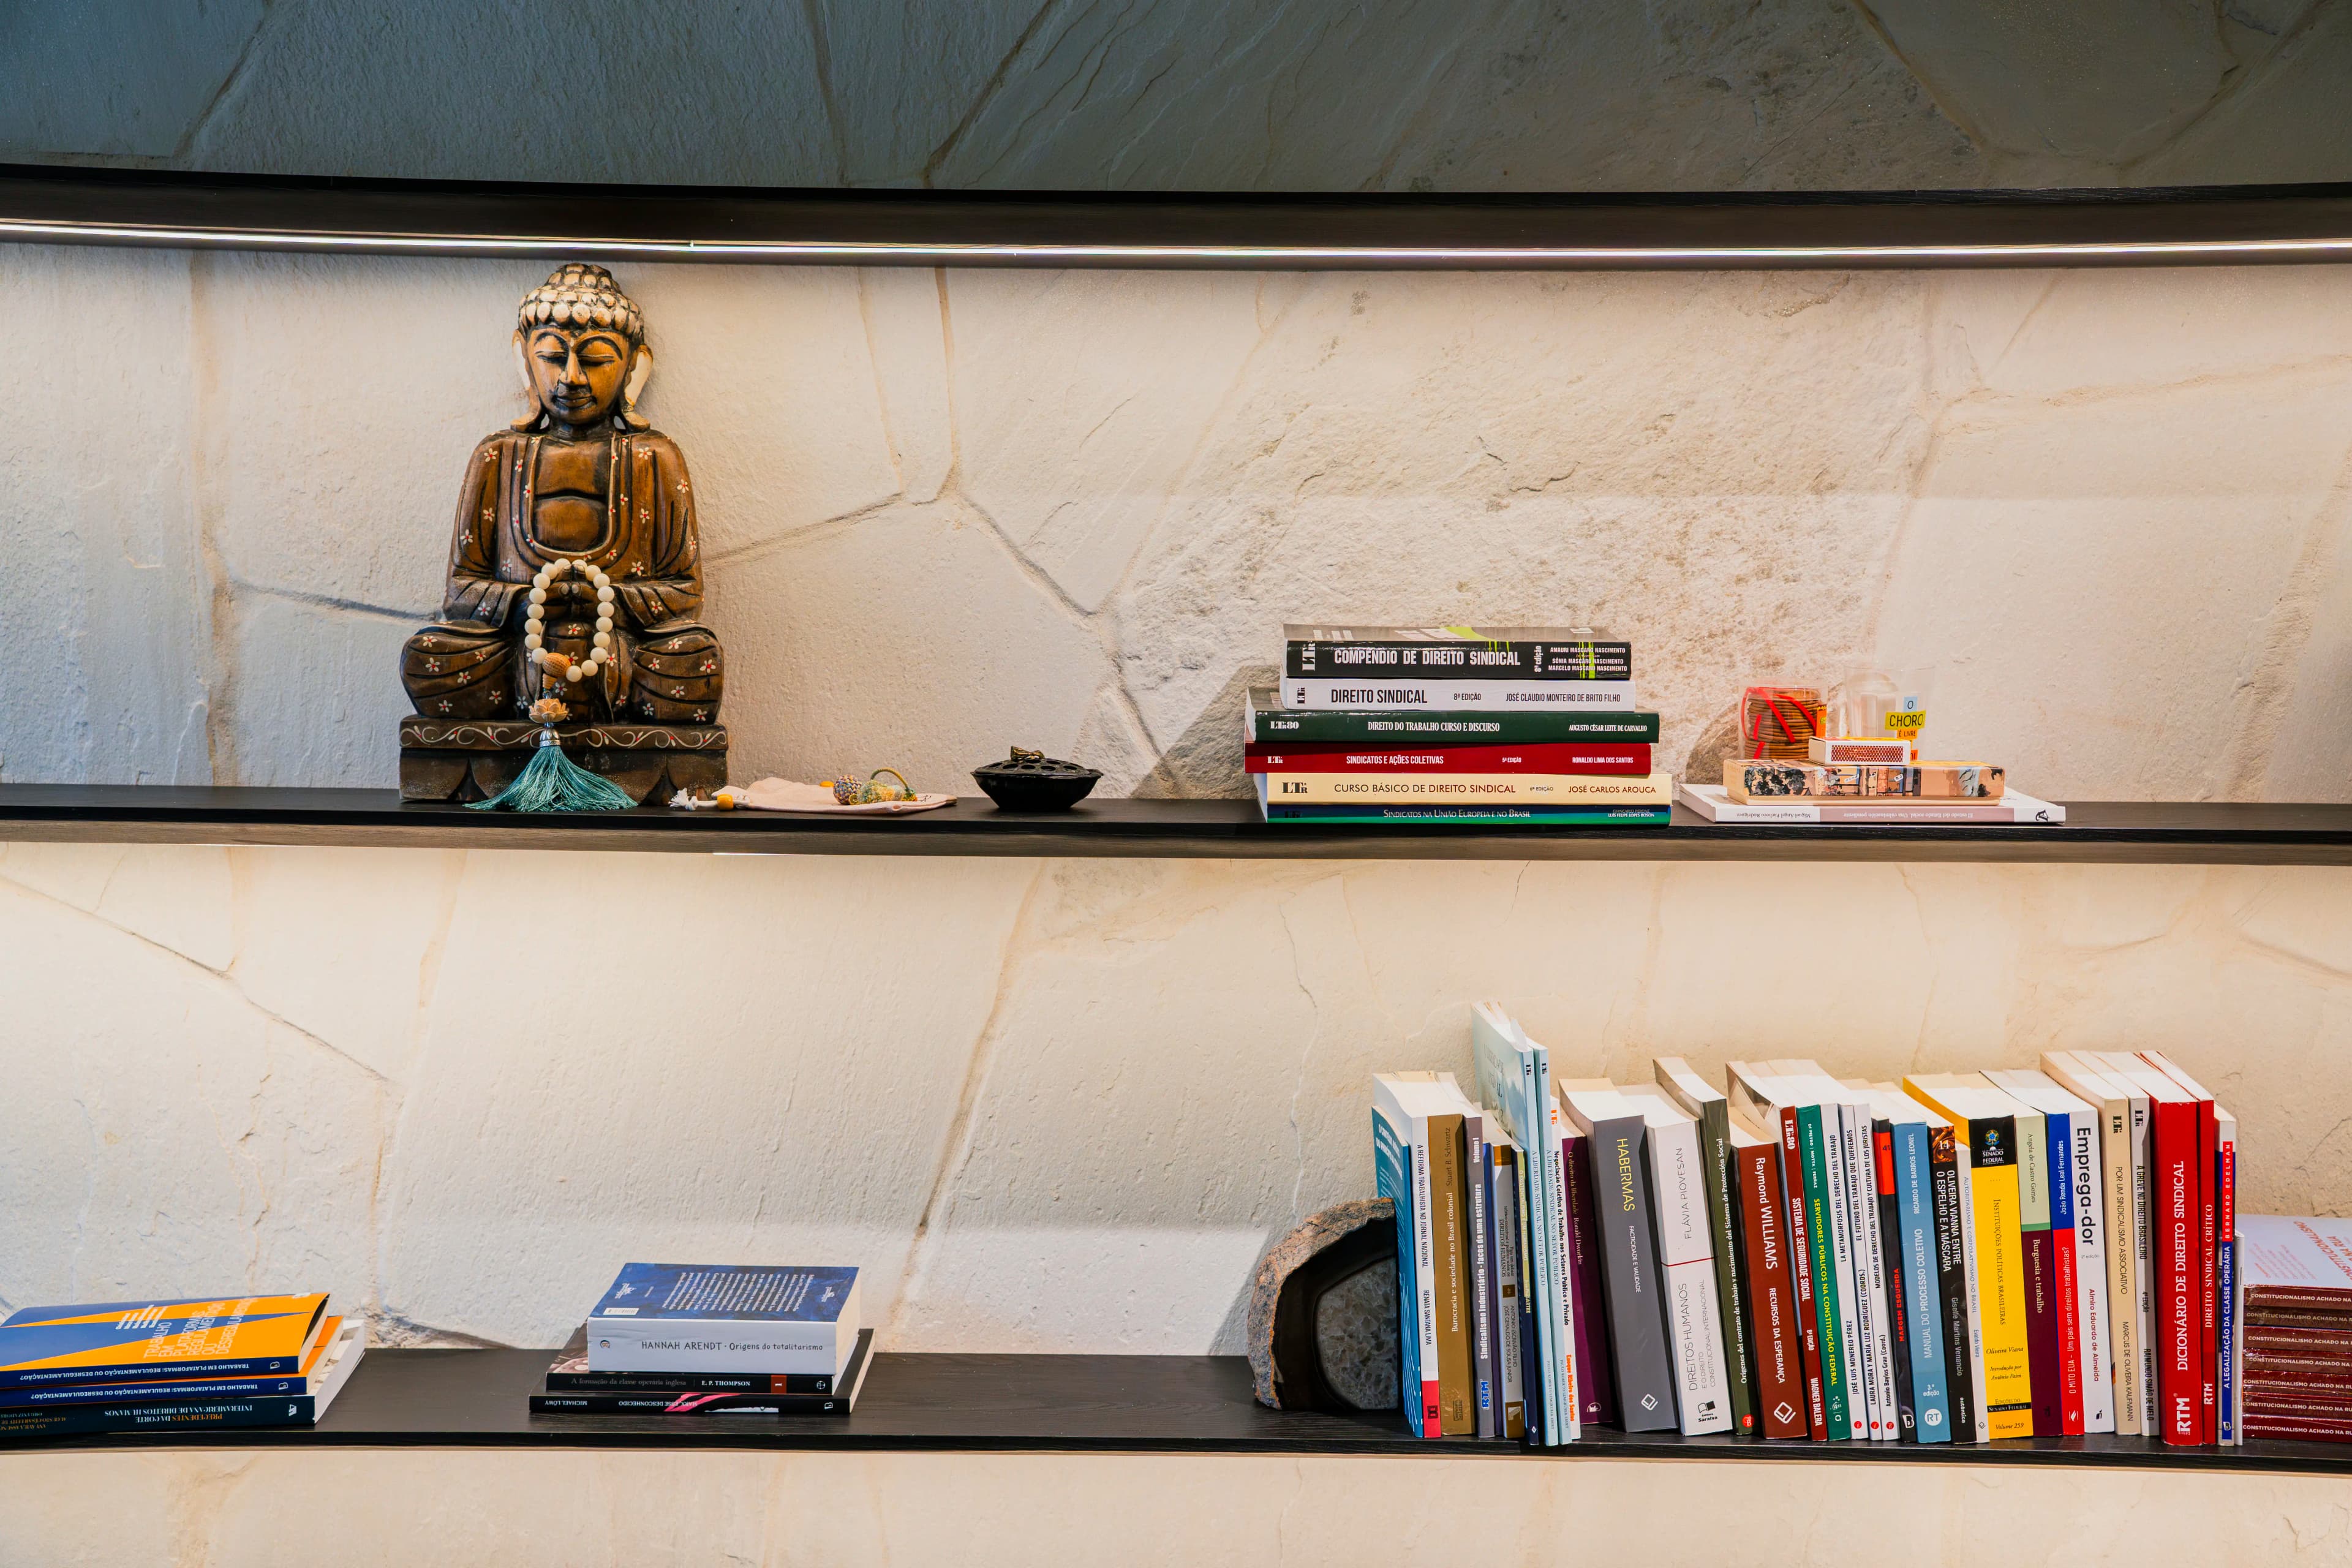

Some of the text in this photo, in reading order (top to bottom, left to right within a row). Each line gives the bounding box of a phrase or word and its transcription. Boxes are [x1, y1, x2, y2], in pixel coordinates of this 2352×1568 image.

[1403, 650, 1417, 664] DE
[1422, 650, 1464, 665] DIREITO
[1469, 650, 1520, 665] SINDICAL
[1331, 689, 1428, 703] DIREITO SINDICAL
[1461, 692, 1481, 702] EDIÇÃO
[1506, 692, 1520, 701] JOSÉ
[1546, 693, 1575, 702] MONTEIRO
[1586, 693, 1603, 702] BRITO
[1907, 701, 1913, 709] O
[1368, 721, 1499, 731] DIREITO DO TRABALHO CURSO E DISCURSO
[1890, 714, 1923, 727] CHORO
[1346, 754, 1444, 765] SINDICATOS E AÇÕES COLETIVAS
[1334, 782, 1516, 793] CURSO BÁSICO DE DIREITO SINDICAL
[1616, 1138, 1635, 1211] HABERMAS
[1675, 1148, 1687, 1200] PIOVESAN
[2074, 1127, 2096, 1245] Emprega-dor
[2116, 1183, 2124, 1195] UM
[1754, 1157, 1777, 1269] Raymond WILLIAMS
[1937, 1179, 1948, 1215] ESPELHO
[1814, 1198, 1823, 1243] SERVIDORES
[1947, 1170, 1961, 1265] OLIVEIRA VIANNA ENTRE
[2117, 1196, 2125, 1246] SINDICALISMO
[2203, 1204, 2212, 1242] CRÍTICO
[1450, 1242, 1455, 1252] no
[1629, 1226, 1638, 1261] FACTICIDADE
[1792, 1197, 1810, 1302] SISTEMA DE SEGURIDADE SOCIAL
[1940, 1232, 1951, 1272] MÁSCARA
[2031, 1238, 2041, 1275] Burguesia
[1448, 1254, 1457, 1287] sociedade
[1818, 1245, 1827, 1281] PÚBLICOS
[2119, 1248, 2128, 1294] ASSOCIATIVO
[2173, 1161, 2188, 1371] DICIONÁRIO DE DIREITO SINDICAL
[1822, 1283, 1828, 1295] NA
[1914, 1229, 1932, 1358] MANUAL DO PROCESSO COLETIVO
[2035, 1282, 2045, 1313] trabalho
[1678, 1283, 1698, 1391] DIREITOS HUMANOS
[1769, 1287, 1785, 1384] RECURSOS DA ESPERANÇA
[1822, 1295, 1834, 1352] CONSTITUIÇÃO
[641, 1341, 680, 1349] HANNAH
[684, 1341, 722, 1351] ARENDT
[729, 1342, 760, 1351] Origens
[1847, 1339, 1856, 1367] MONEREO
[20, 1371, 93, 1381] DESREGULAMENTAÇÃO?
[104, 1368, 161, 1376] REGULAMENTAÇÃO
[1850, 1382, 1860, 1394] JOSÉ
